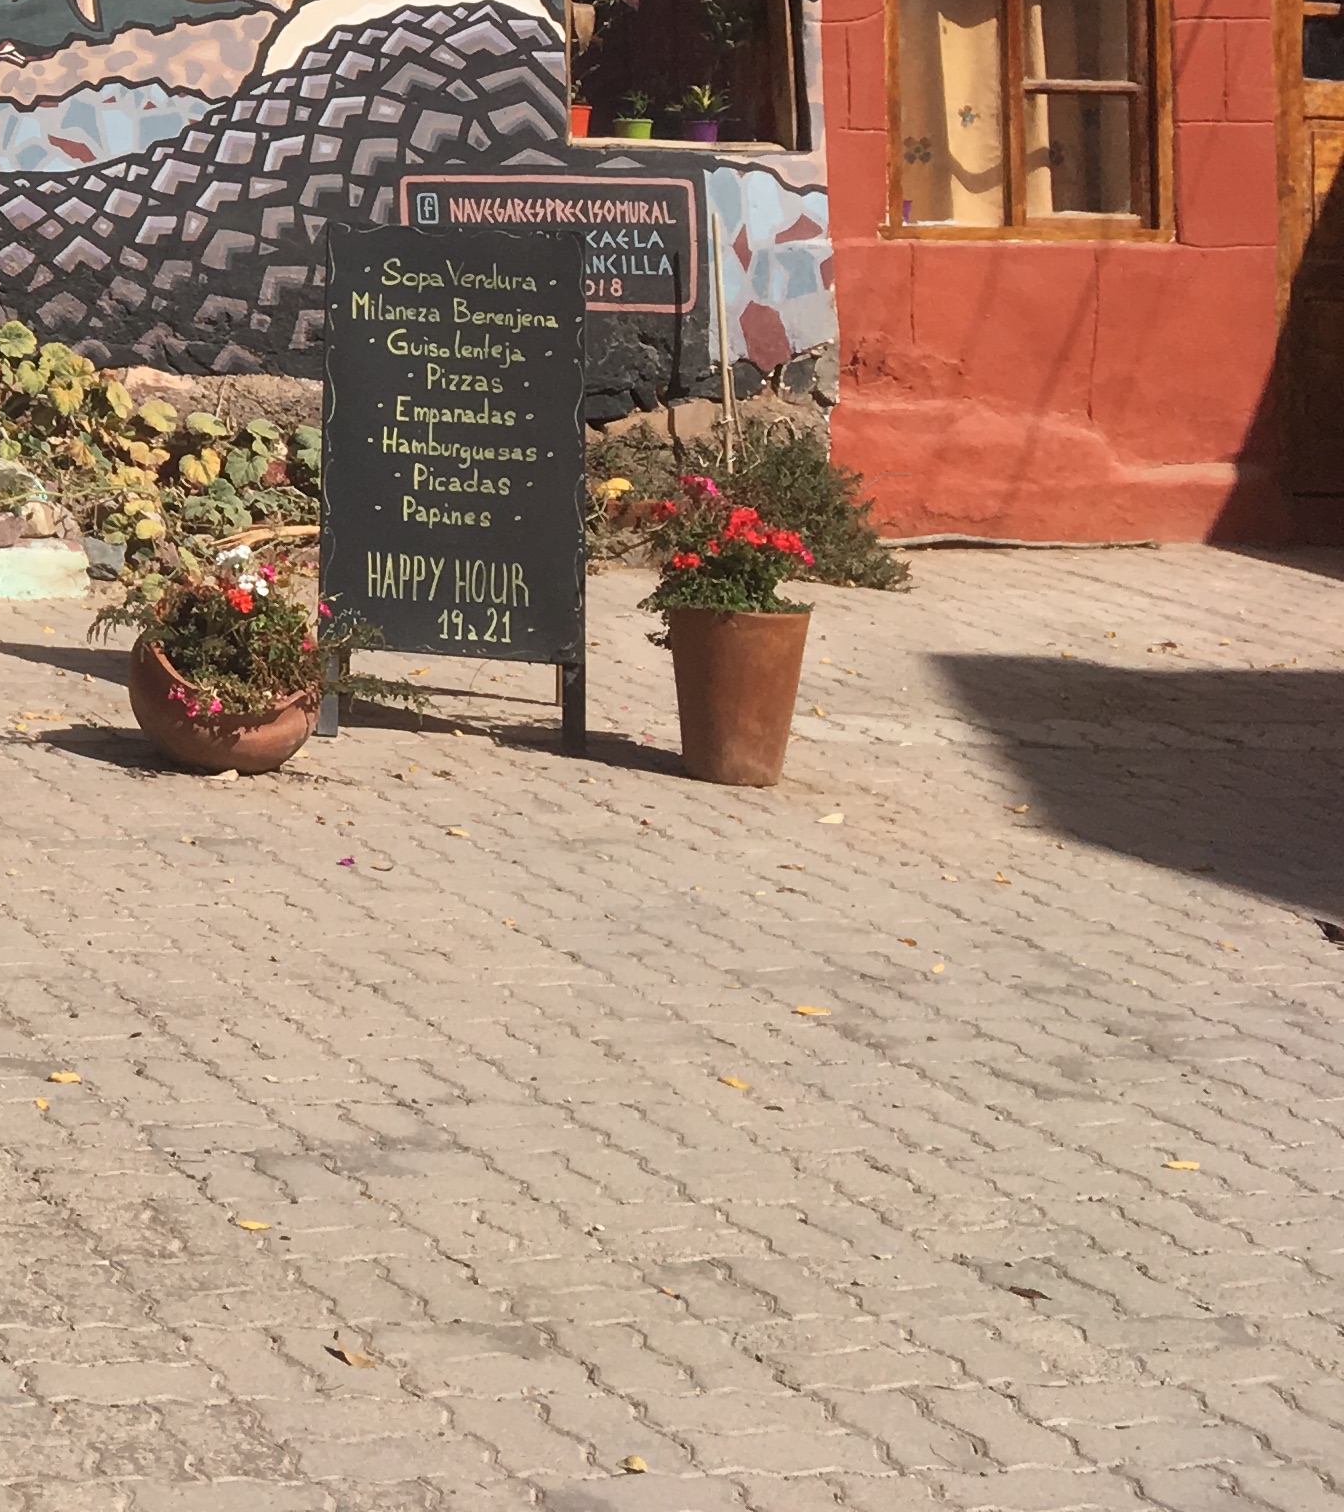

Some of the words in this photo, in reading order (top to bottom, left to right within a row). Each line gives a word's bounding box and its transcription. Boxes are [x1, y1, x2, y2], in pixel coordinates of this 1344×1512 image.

[448, 197, 677, 225] NAVEGARESPRECISOMURAL
[585, 228, 665, 250] CAELA
[381, 257, 444, 293] Sopa
[445, 259, 537, 292] Verdura
[585, 253, 674, 276] NCILLA
[351, 291, 441, 323] Milaneza
[453, 297, 559, 333] Berenjena
[387, 328, 451, 358] Guiso
[454, 330, 526, 368] lenteja
[426, 362, 504, 394] Pizzas
[395, 395, 517, 433] Empanadas
[382, 425, 538, 469] Hamburguesas
[413, 462, 512, 496] Picadas
[403, 495, 492, 529] Papines
[367, 550, 446, 602] HAPPY
[454, 558, 530, 608] HOUR
[437, 608, 464, 641] 19
[483, 607, 512, 644] 21
